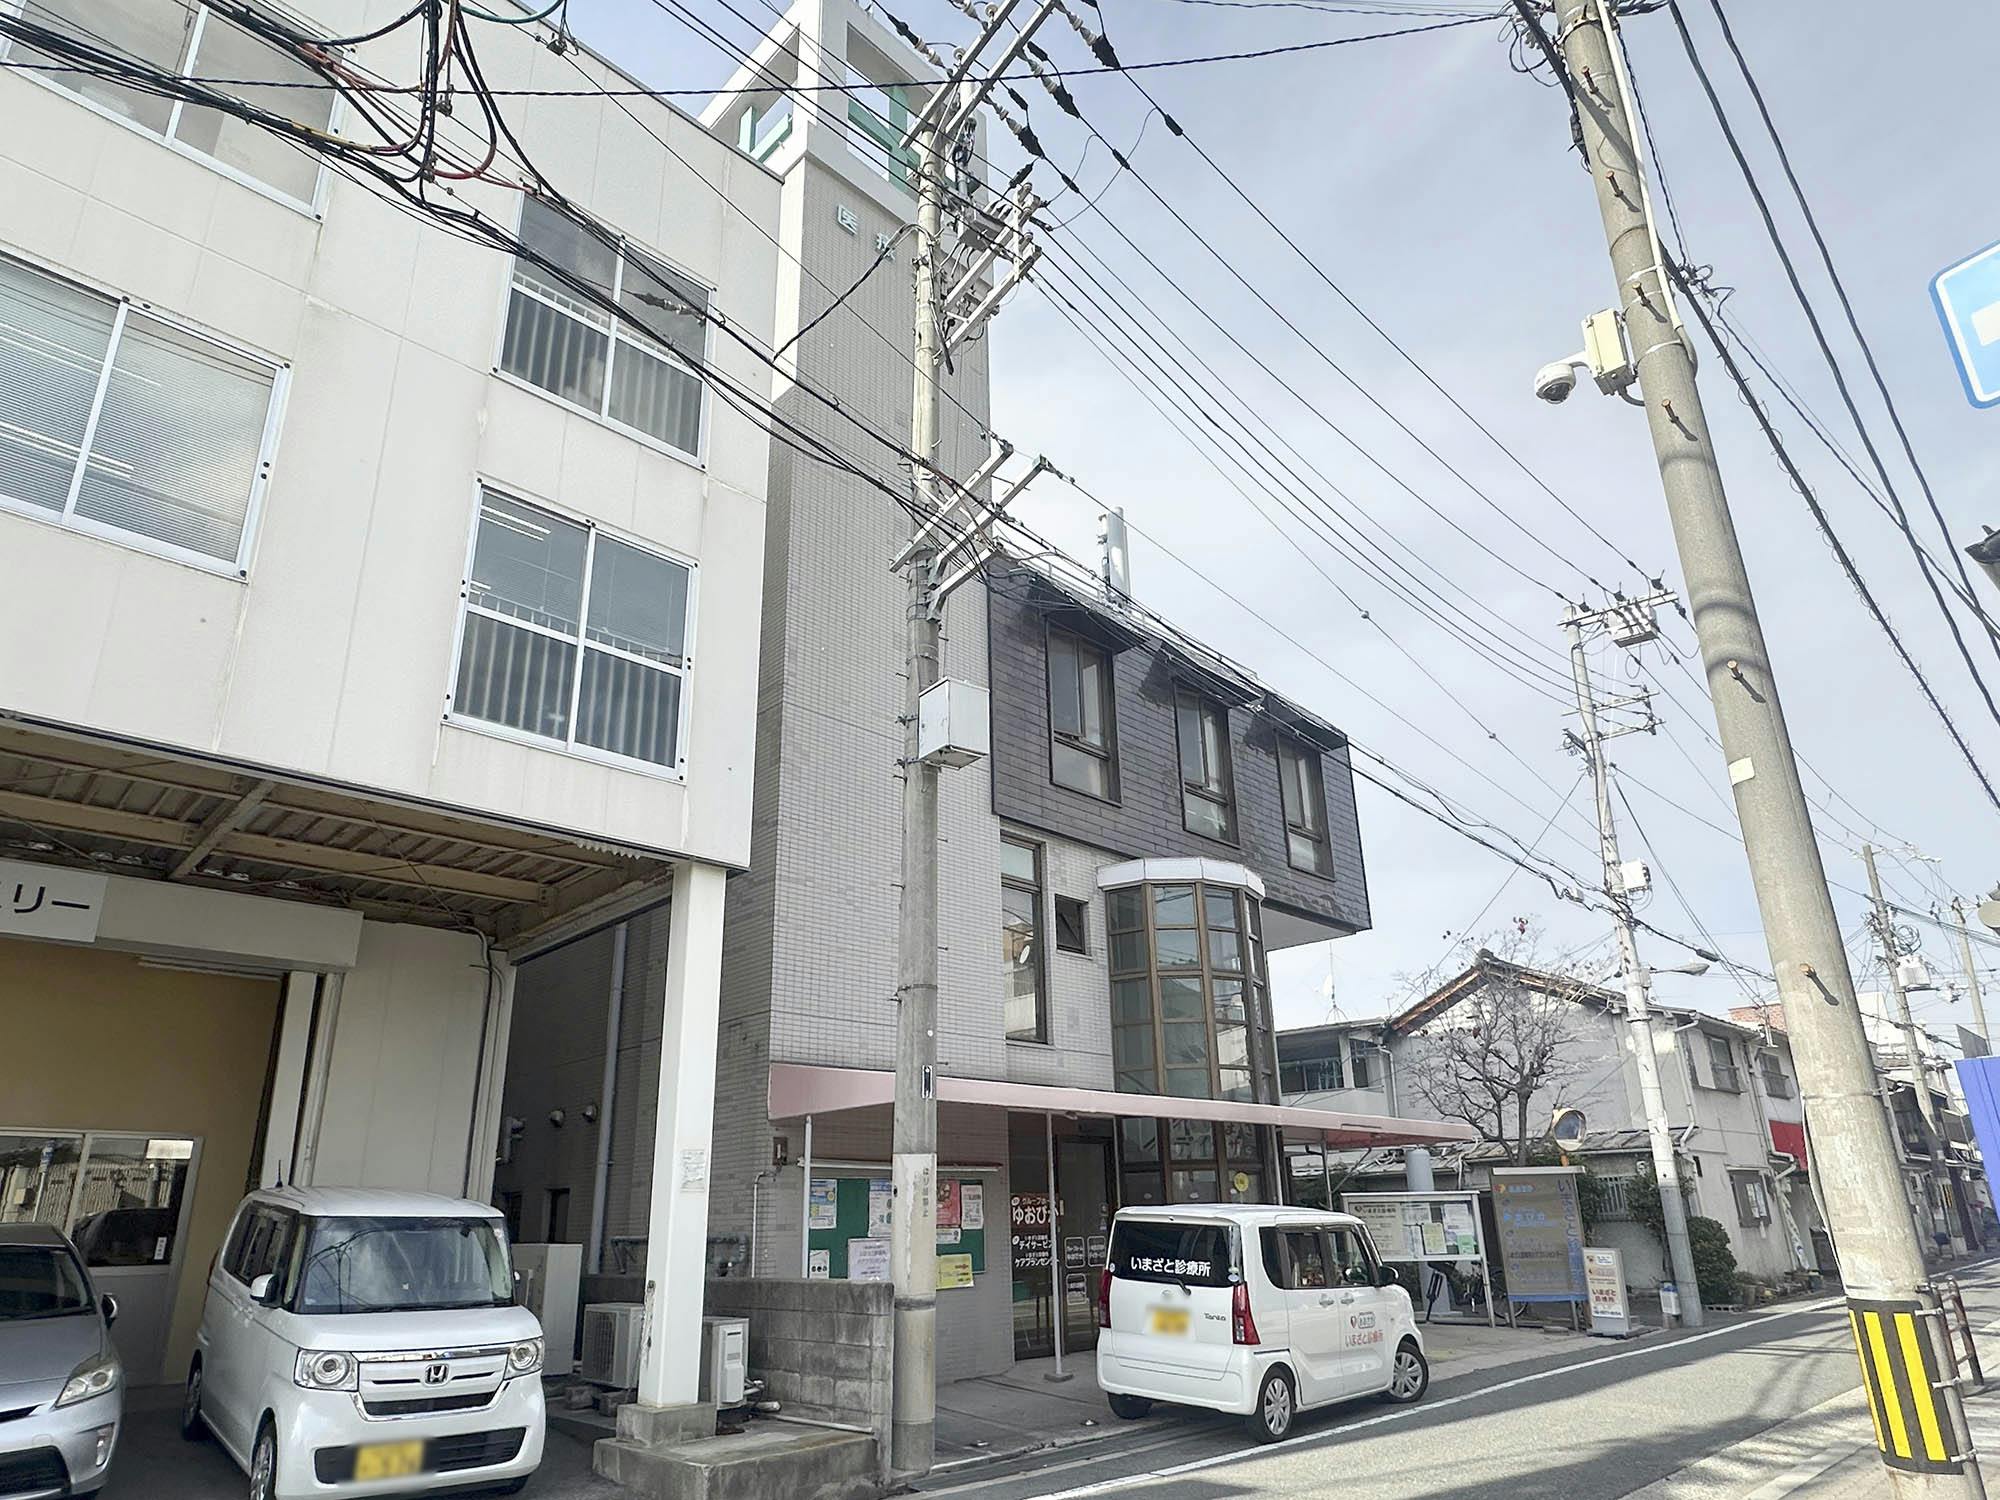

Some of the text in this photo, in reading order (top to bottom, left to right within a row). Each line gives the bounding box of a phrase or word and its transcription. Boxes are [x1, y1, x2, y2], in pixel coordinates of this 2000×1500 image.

[0, 883, 90, 914] リー
[1014, 1257, 1060, 1268] ケアプランセン
[1130, 1256, 1212, 1277] いまざと診療所
